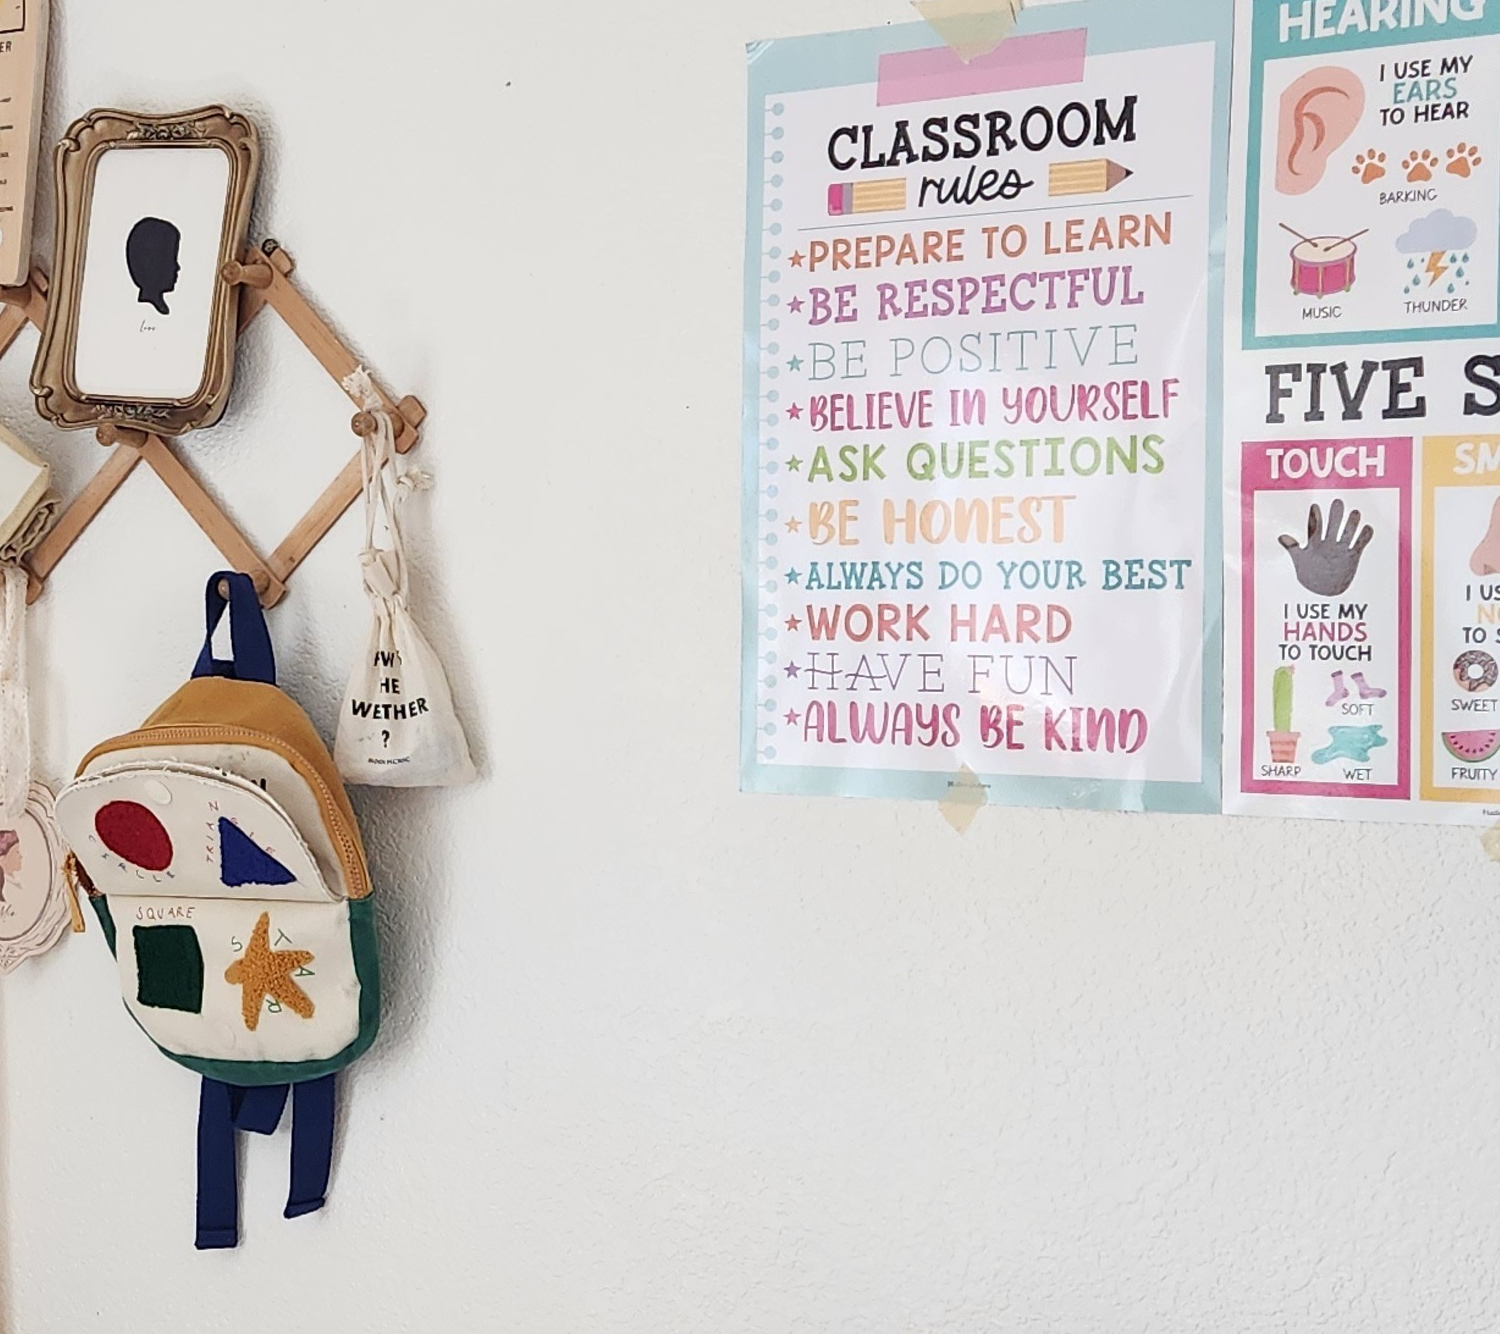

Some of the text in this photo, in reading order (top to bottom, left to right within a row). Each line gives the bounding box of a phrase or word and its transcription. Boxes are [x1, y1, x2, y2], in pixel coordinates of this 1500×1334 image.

[1380, 55, 1474, 82] I USE MY
[1393, 78, 1457, 104] EARS
[1379, 102, 1469, 126] TO HEAR
[827, 94, 1138, 171] CLASSROOM
[918, 165, 1034, 207] rules
[1379, 188, 1438, 205] BARKING
[808, 212, 1172, 272] PREPARE TO LEARN
[808, 266, 1144, 326] BE RESPECTFUL
[1404, 299, 1468, 314] THUNDER
[1302, 306, 1342, 319] MUSIC
[808, 324, 1139, 381] BE POSITIVE
[1265, 356, 1427, 423] FIVE
[810, 390, 933, 431] BELIEVE
[1002, 378, 1180, 425] YOURSELF
[808, 434, 1165, 483] ASK QUESTIONS
[1265, 444, 1386, 479] TOUCH
[808, 499, 860, 546] BE
[805, 559, 1192, 590] ALWAYS DO YOUR BEST
[805, 604, 1072, 643] WORK HARD
[1284, 604, 1368, 619] I USE MY
[1284, 622, 1368, 642] HANDS
[1463, 627, 1487, 643] TO
[1279, 644, 1371, 661] TO TOUCH
[804, 652, 1077, 695] HAVE FUN
[351, 697, 429, 720] WETHER
[1341, 703, 1374, 716] SOFT
[1451, 699, 1498, 712] SWEET
[804, 700, 961, 746] ALWAYS
[980, 704, 1024, 749] BE
[381, 729, 390, 748] ?
[1261, 765, 1301, 777] SHARP
[1343, 768, 1373, 780] WET
[1452, 767, 1498, 780] FRUITY
[136, 906, 195, 921] SQUARE
[231, 928, 315, 1015] STAR
